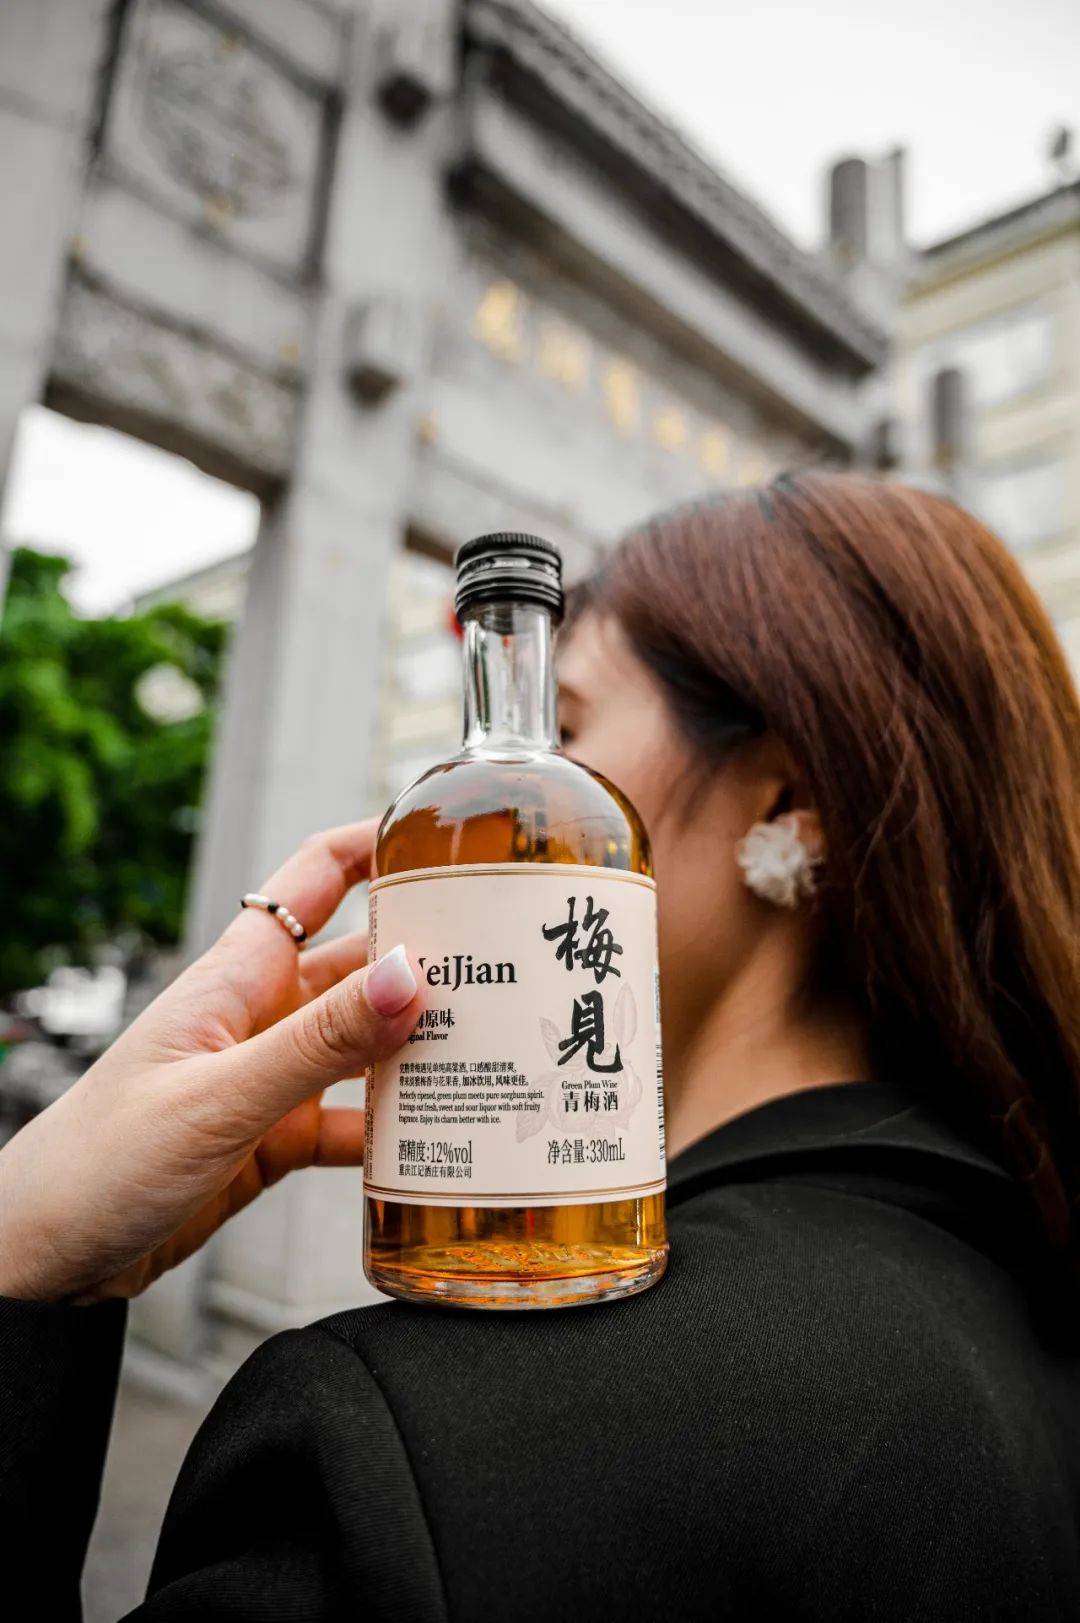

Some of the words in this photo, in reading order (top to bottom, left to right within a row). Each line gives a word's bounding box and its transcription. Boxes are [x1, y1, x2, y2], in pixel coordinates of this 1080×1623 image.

[418, 955, 518, 992] eiJian
[426, 1031, 449, 1041] Flavor
[562, 1081, 582, 1089] Green
[584, 1080, 600, 1089] Plum
[601, 1080, 618, 1088] Wine
[437, 1093, 452, 1102] green
[452, 1091, 467, 1101] plum
[468, 1092, 485, 1100] meets
[486, 1093, 500, 1101] pure
[500, 1090, 526, 1101] sorghum
[527, 1090, 544, 1101] spirit.
[562, 1091, 618, 1112] 青梅酒
[454, 1103, 465, 1111] and
[479, 1103, 497, 1113] liquor
[498, 1103, 511, 1111] with
[512, 1102, 523, 1110] soft
[524, 1102, 541, 1112] fruity
[420, 1115, 433, 1125] Enjoy
[441, 1115, 458, 1123] charm
[459, 1115, 475, 1123] better
[477, 1115, 490, 1123] with
[490, 1114, 501, 1123] ice.
[399, 1164, 472, 1178] 重庆江记酒庄有限公司
